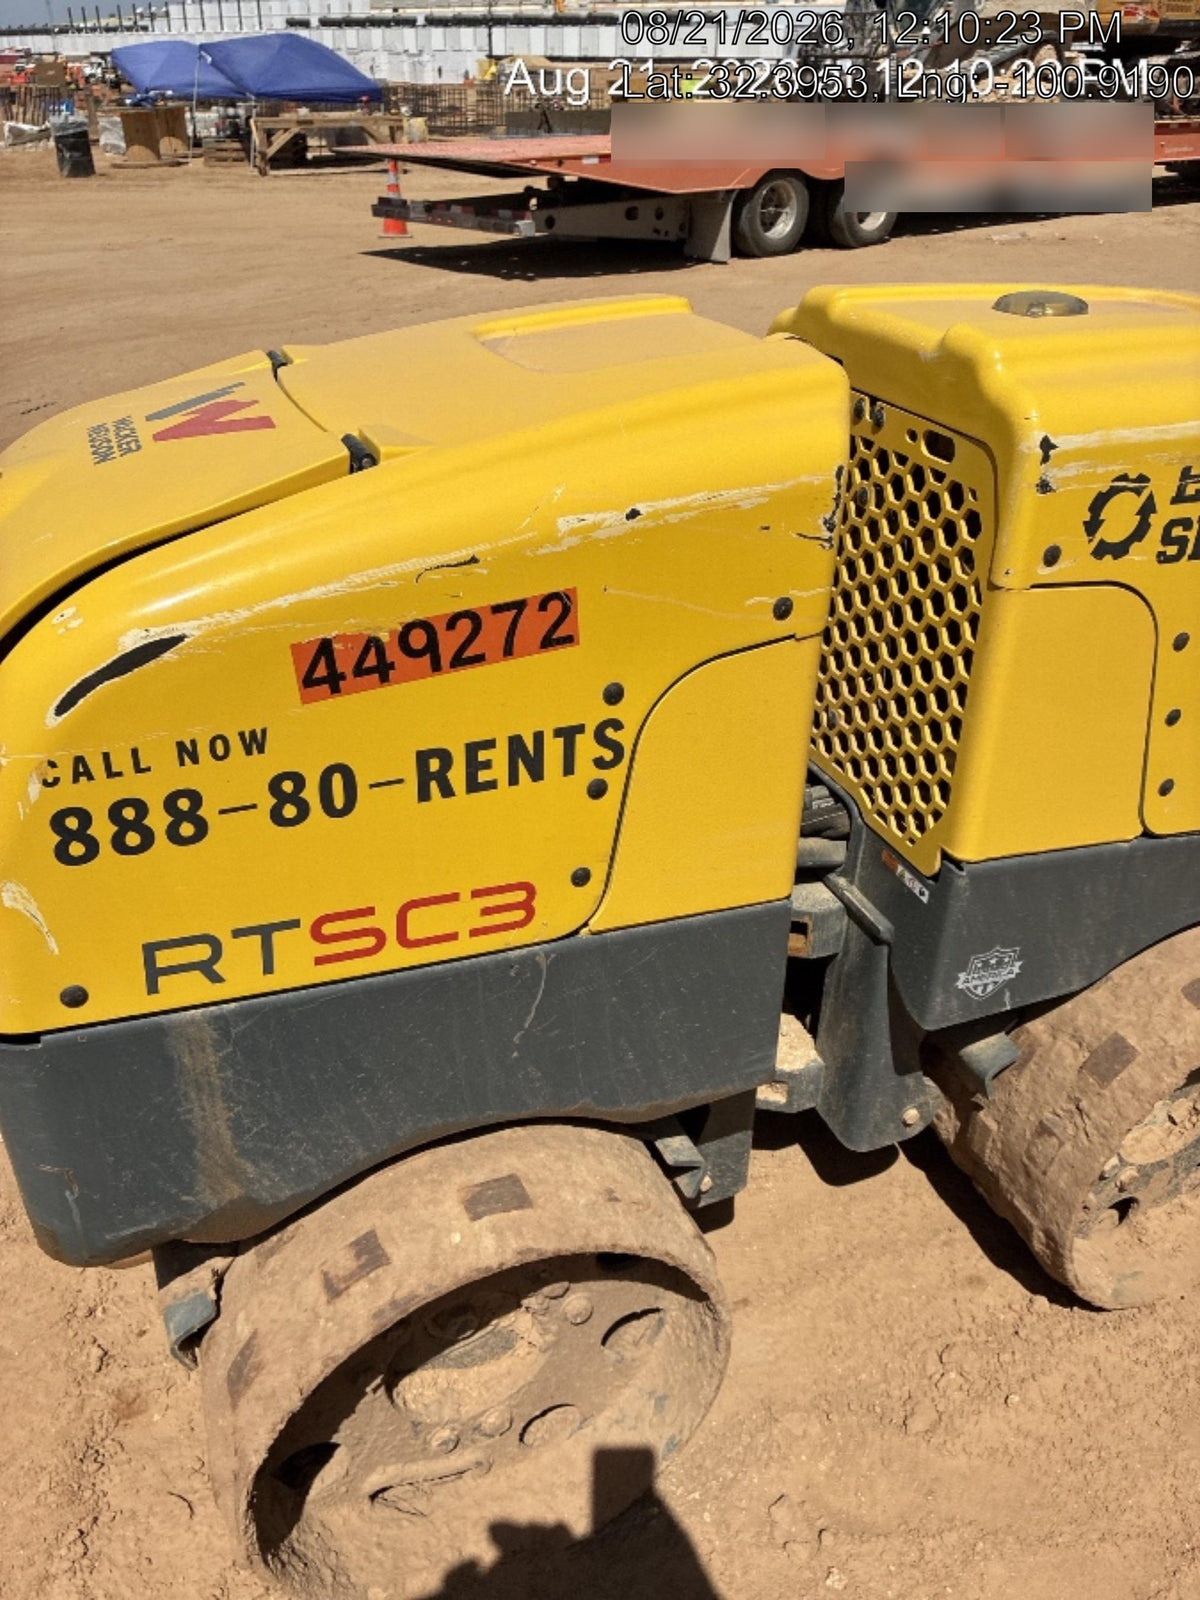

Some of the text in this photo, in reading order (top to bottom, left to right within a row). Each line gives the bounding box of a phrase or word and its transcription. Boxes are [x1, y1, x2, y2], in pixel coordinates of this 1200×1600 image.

[302, 591, 576, 694] 449272
[42, 726, 270, 788] CALL NOW
[49, 717, 627, 867] 888-80-RENTS
[142, 880, 538, 996] RTSC3
